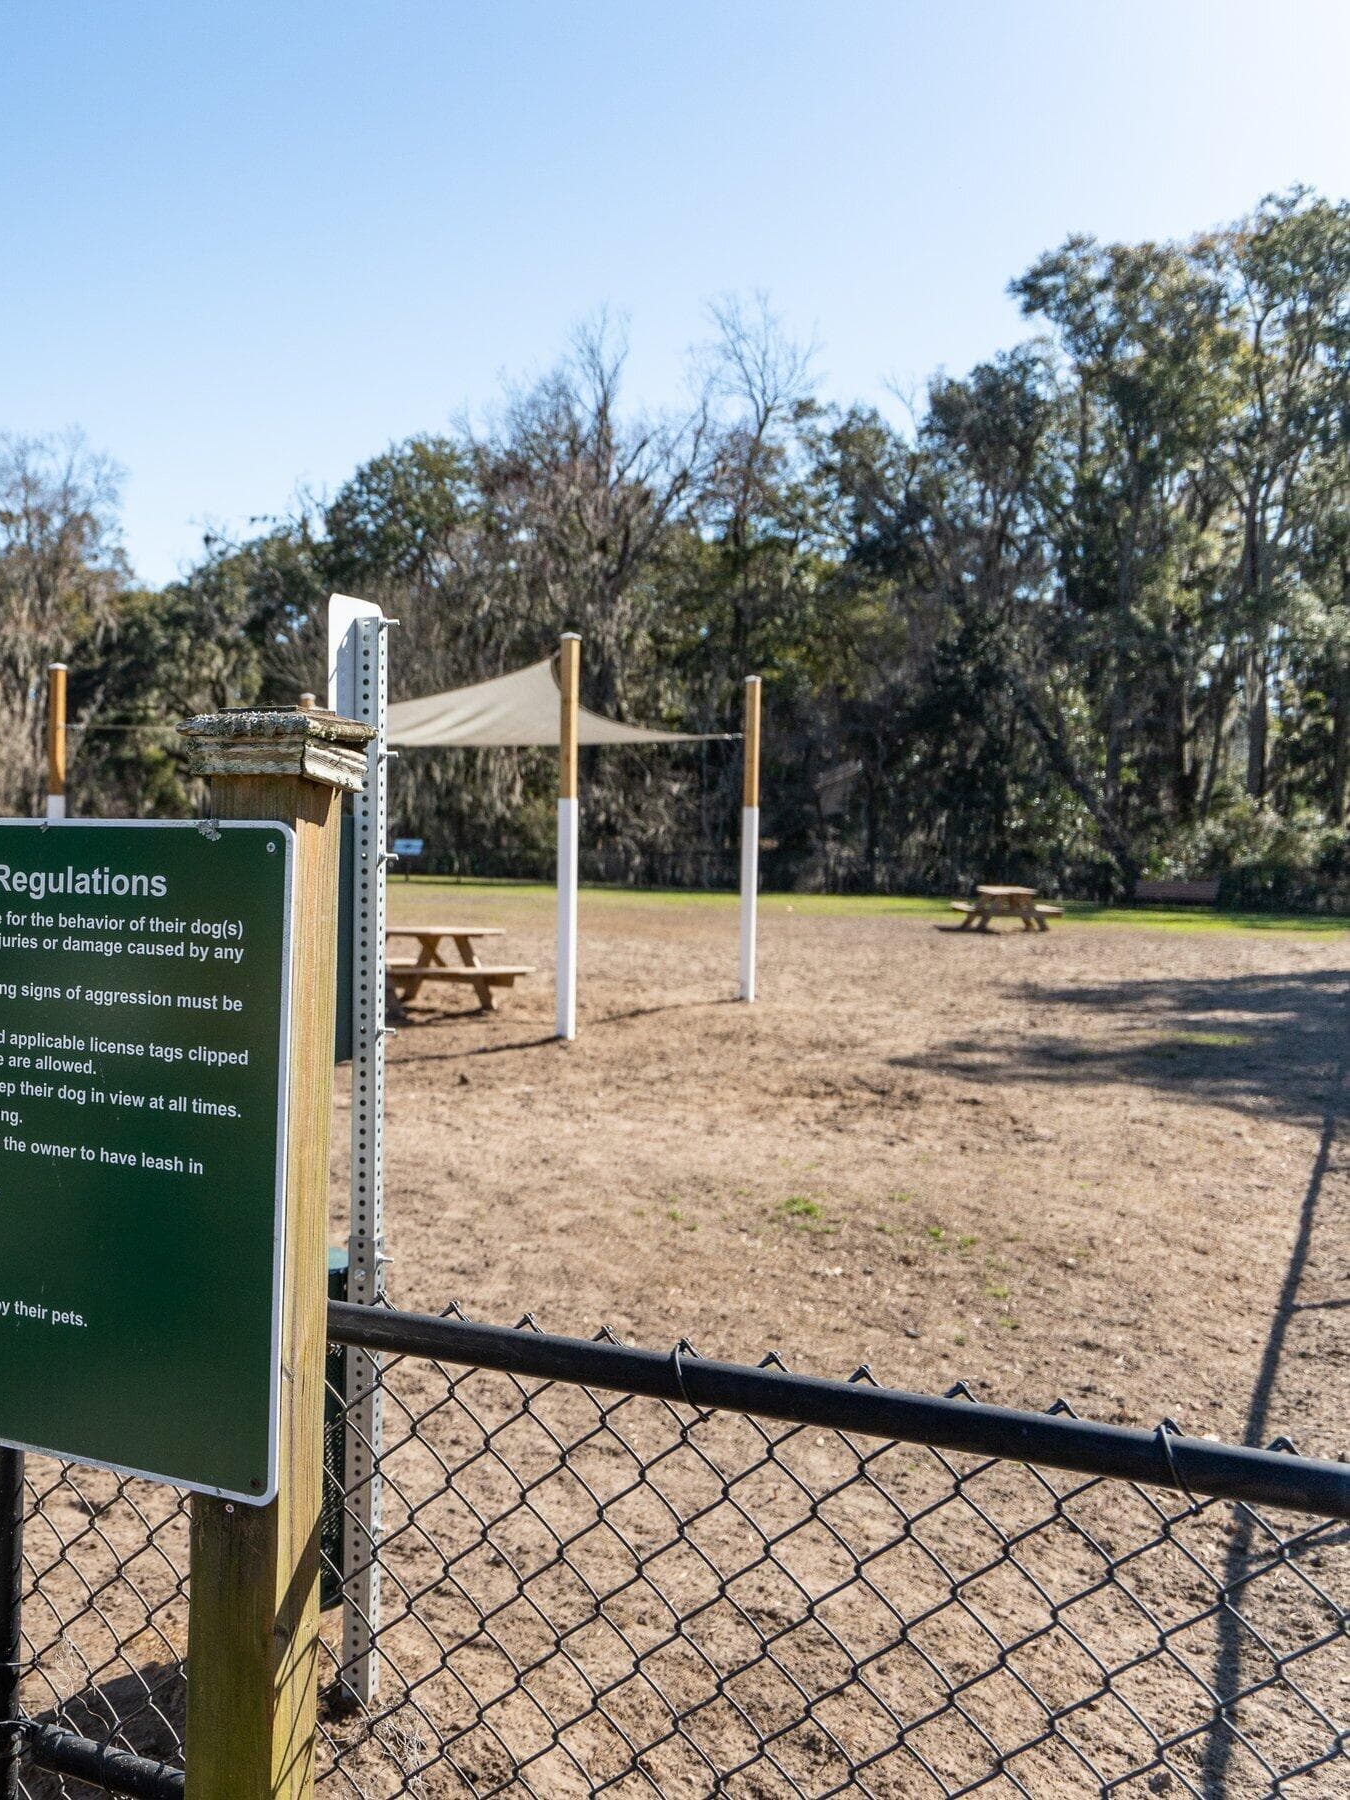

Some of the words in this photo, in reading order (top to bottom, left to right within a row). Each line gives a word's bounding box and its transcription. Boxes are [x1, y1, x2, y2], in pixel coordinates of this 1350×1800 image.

[5, 910, 28, 927] for
[30, 911, 54, 928] the
[58, 912, 126, 931] behavior
[129, 916, 147, 932] of
[148, 916, 187, 934] their
[190, 918, 244, 940] dog(s)
[9, 1032, 86, 1051] applicable
[90, 1036, 145, 1057] license
[148, 1042, 184, 1063] tags
[188, 1045, 249, 1067] clipped
[8, 1055, 31, 1069] are
[35, 1055, 97, 1075] allowed.
[3, 1135, 27, 1153] the
[30, 1142, 77, 1159] owner
[79, 1145, 96, 1161] to
[100, 1146, 137, 1167] have
[141, 1151, 184, 1173] leash
[188, 1157, 204, 1175] in
[13, 1300, 49, 1320] their
[51, 1309, 88, 1328] pets.
